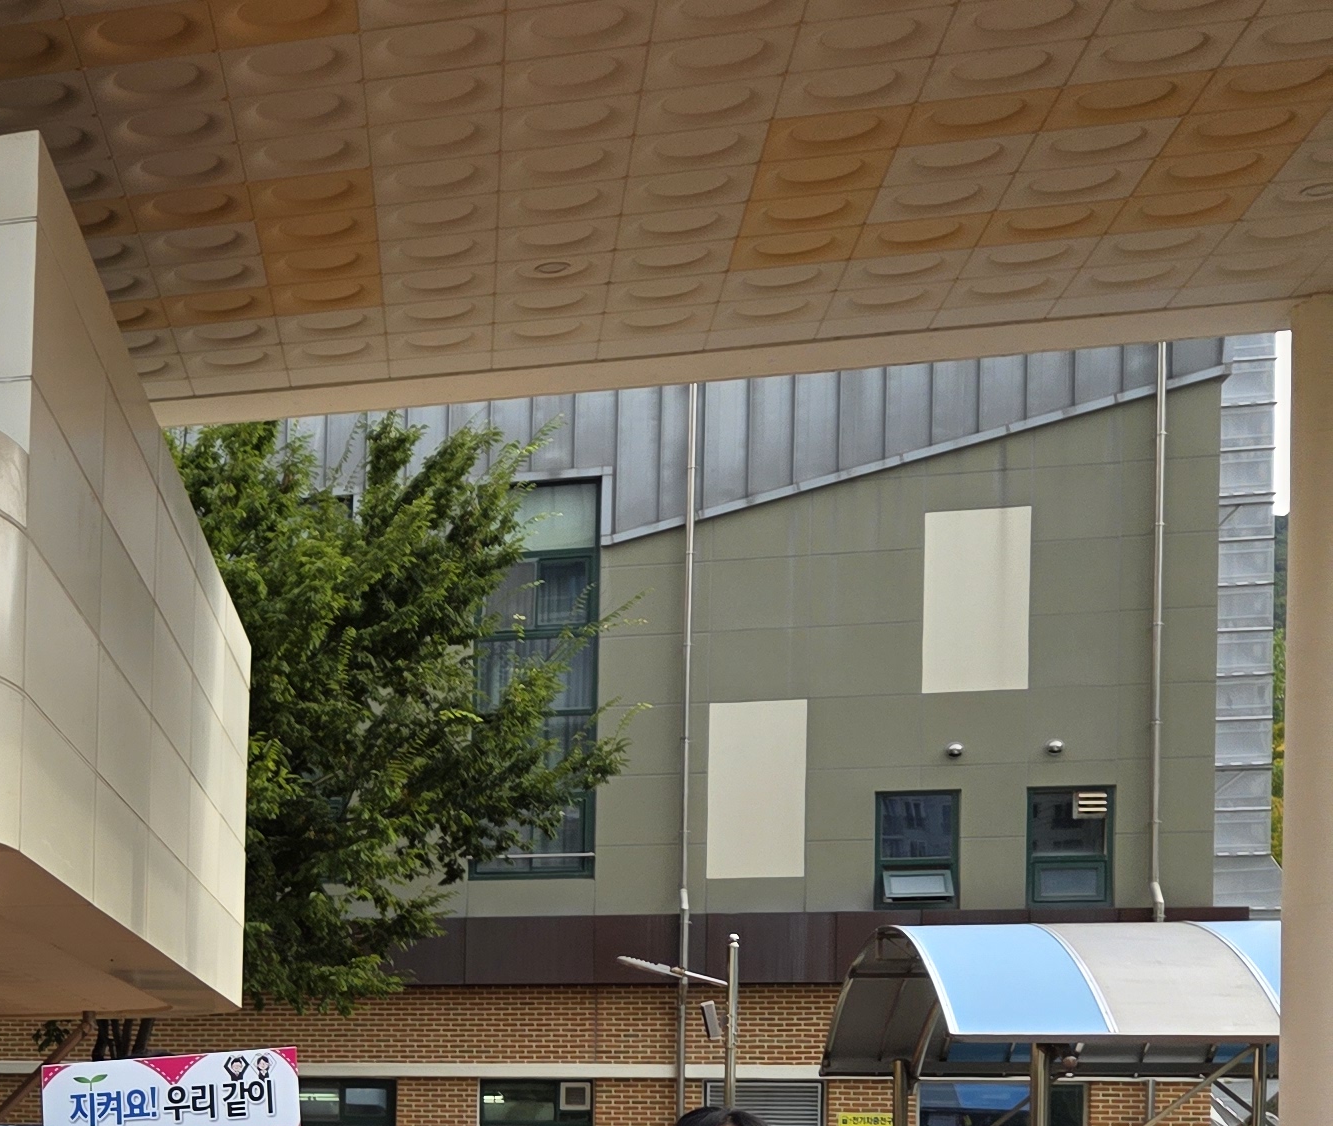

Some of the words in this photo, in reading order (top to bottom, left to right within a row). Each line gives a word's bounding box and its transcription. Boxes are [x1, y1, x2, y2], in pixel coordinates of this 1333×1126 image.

[69, 1086, 157, 1126] 지켜요!
[163, 1084, 216, 1121] 우리
[222, 1080, 274, 1117] 같이
